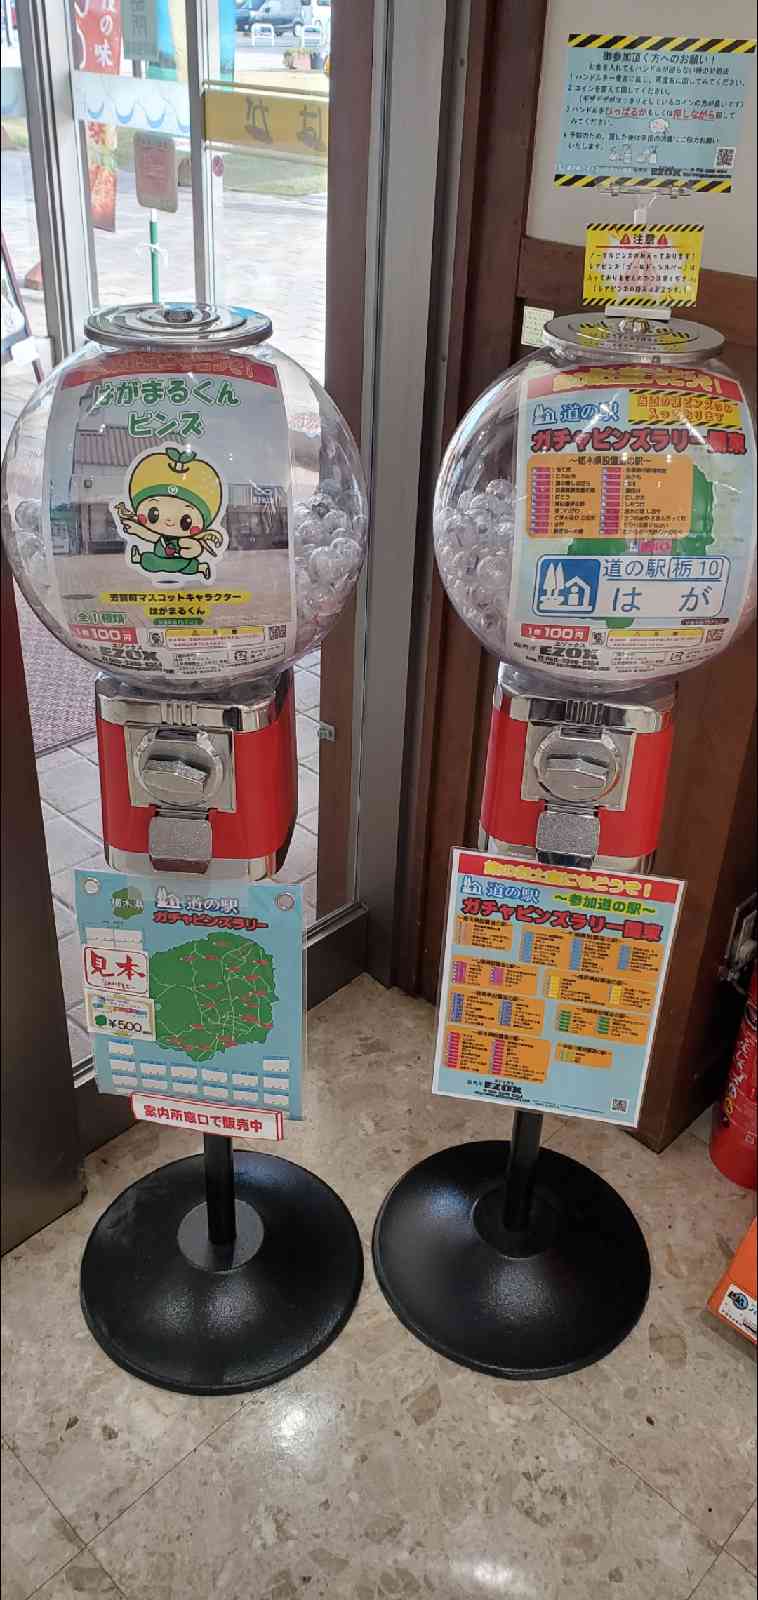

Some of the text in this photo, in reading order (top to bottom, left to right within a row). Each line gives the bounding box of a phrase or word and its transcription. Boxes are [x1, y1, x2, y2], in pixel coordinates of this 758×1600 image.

[633, 233, 657, 245] 注意
[95, 378, 241, 407] はがまるくん
[128, 410, 206, 438] ピンズ
[602, 558, 721, 578] 道の駅 栃 10
[611, 586, 713, 613] はが
[149, 607, 206, 617] はがまるくん
[485, 882, 541, 904] 道の駅
[186, 896, 240, 914] 道の駅
[153, 911, 269, 931] ガチャピンズラリー
[90, 949, 146, 980] 見本
[143, 1104, 263, 1134] 案内所窓口で販売中
